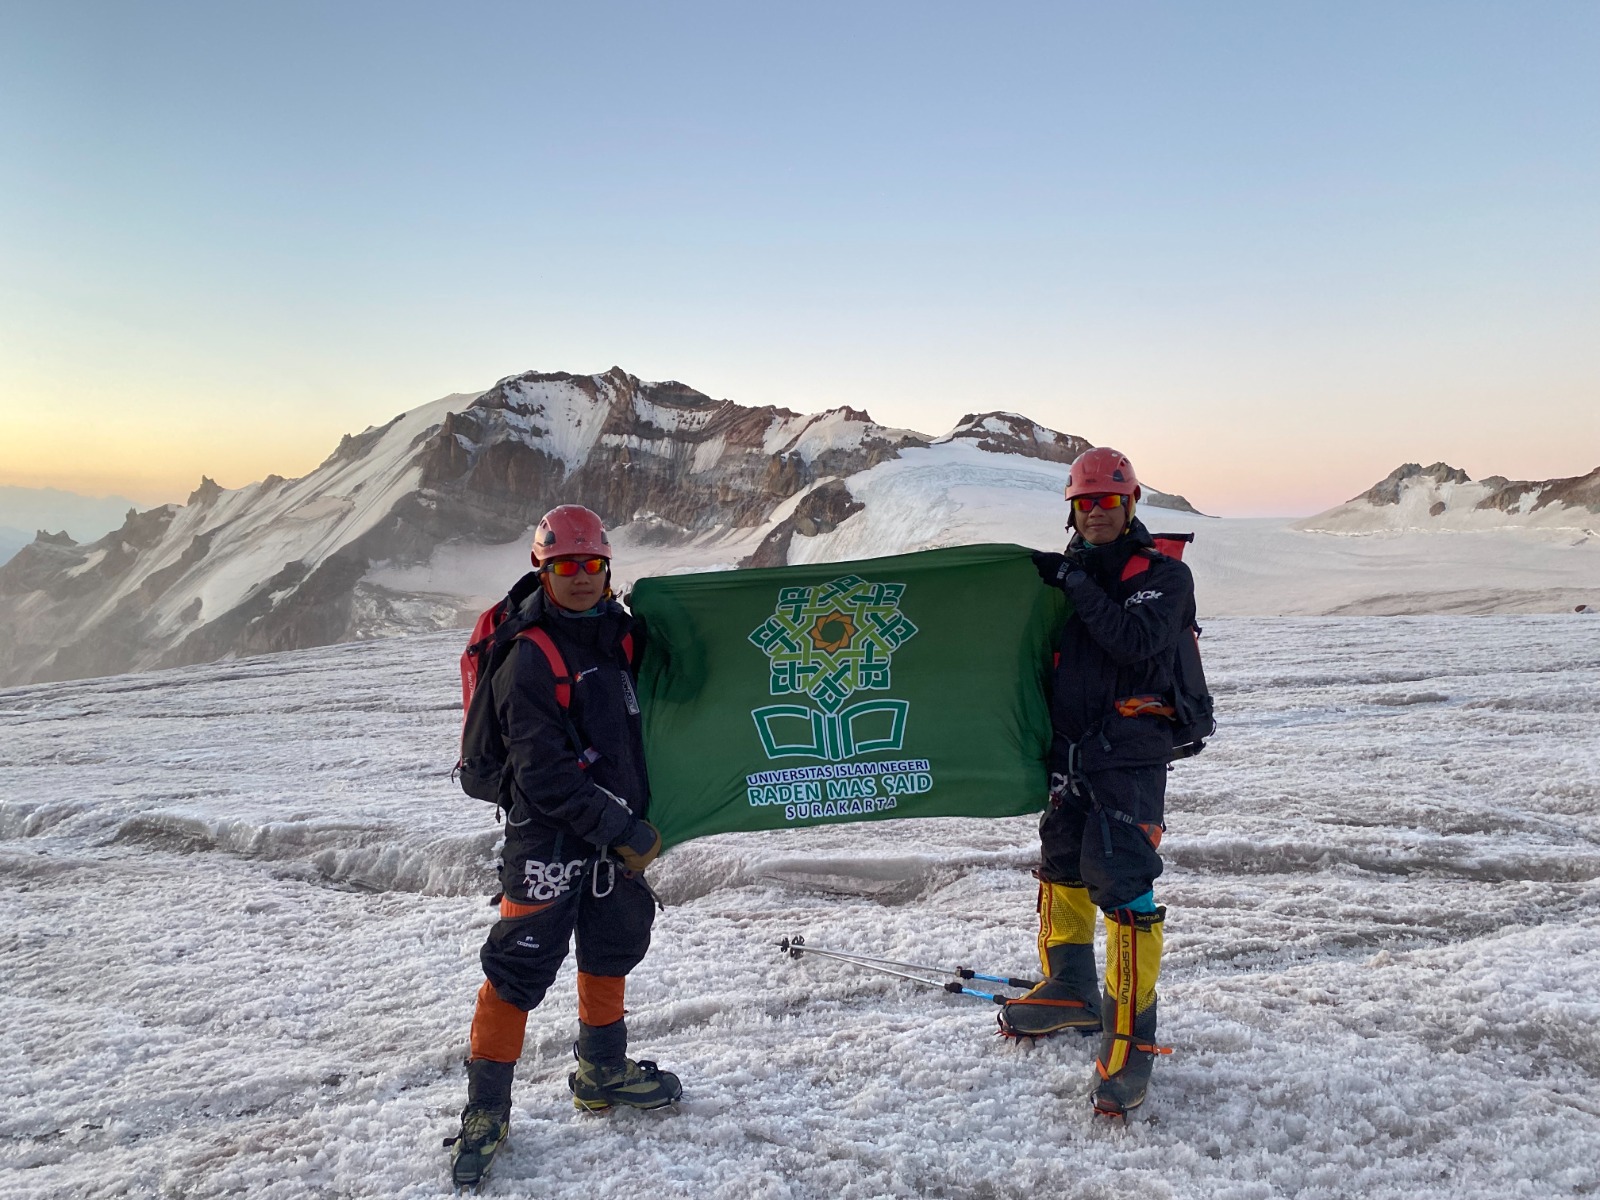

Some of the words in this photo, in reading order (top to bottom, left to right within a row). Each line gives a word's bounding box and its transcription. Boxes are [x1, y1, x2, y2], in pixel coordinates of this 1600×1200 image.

[746, 766, 832, 786] UNIVERSITAS
[834, 761, 878, 778] ISLAM
[878, 759, 930, 774] NEGERI
[748, 782, 821, 806] RADEN
[826, 777, 877, 799] MAS
[882, 772, 933, 796] SAID
[785, 796, 898, 820] SURAKARTA
[1121, 934, 1130, 948] LA
[1121, 951, 1132, 1005] SPORTIVA
